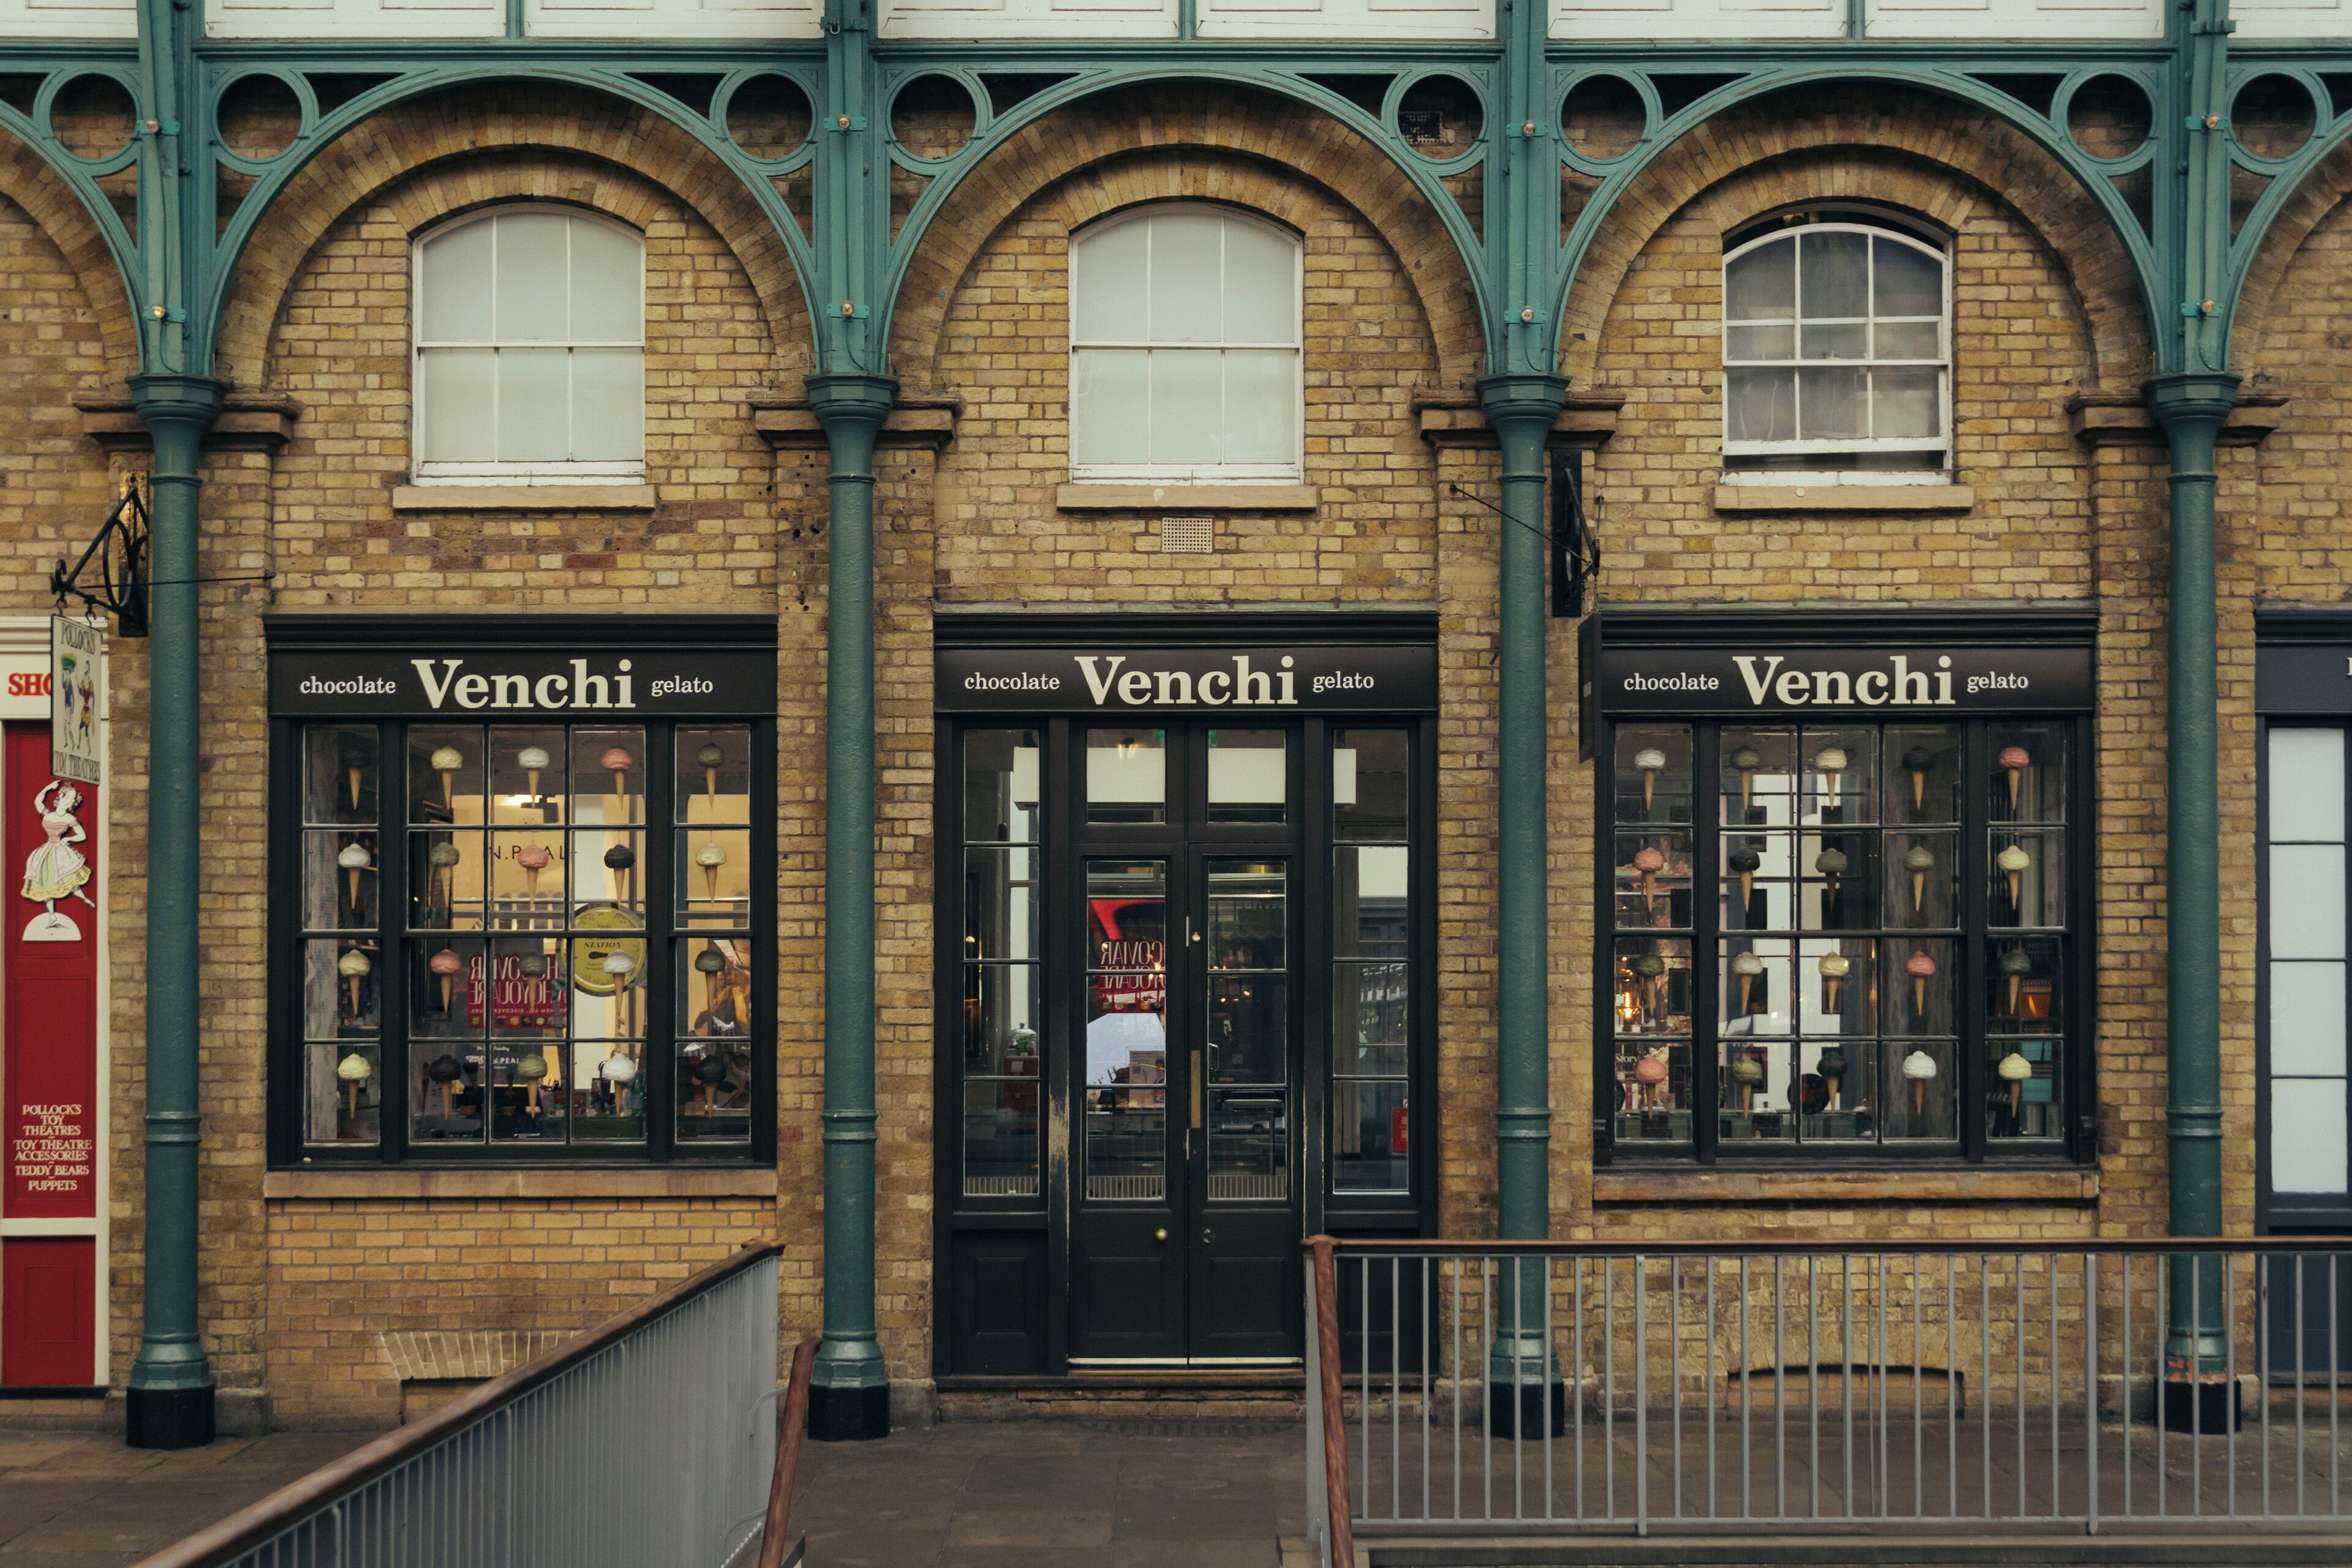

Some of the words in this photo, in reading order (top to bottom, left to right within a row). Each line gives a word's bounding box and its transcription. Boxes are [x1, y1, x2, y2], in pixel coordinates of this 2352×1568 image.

[300, 675, 396, 694] chocolate
[410, 658, 636, 709] Venchi
[651, 675, 714, 697] gelato
[964, 671, 1060, 690] chocolate
[1074, 655, 1298, 705] Venchi
[1313, 671, 1374, 693] gelato
[1624, 672, 1719, 690] chocolate
[1732, 655, 1956, 705] Venchi
[1967, 671, 2029, 693] gelato
[489, 845, 565, 859] N.PAL
[22, 1104, 82, 1115] POLLOCK'S
[40, 1115, 65, 1126] TOY
[23, 1125, 81, 1136] THEATRES
[13, 1139, 39, 1150] TOY
[39, 1139, 92, 1150] THEATRE
[14, 1150, 89, 1161] ACCESSORIES
[15, 1165, 53, 1176] TEDDY
[54, 1165, 90, 1176] BEARS
[28, 1180, 78, 1191] PUPPETS
